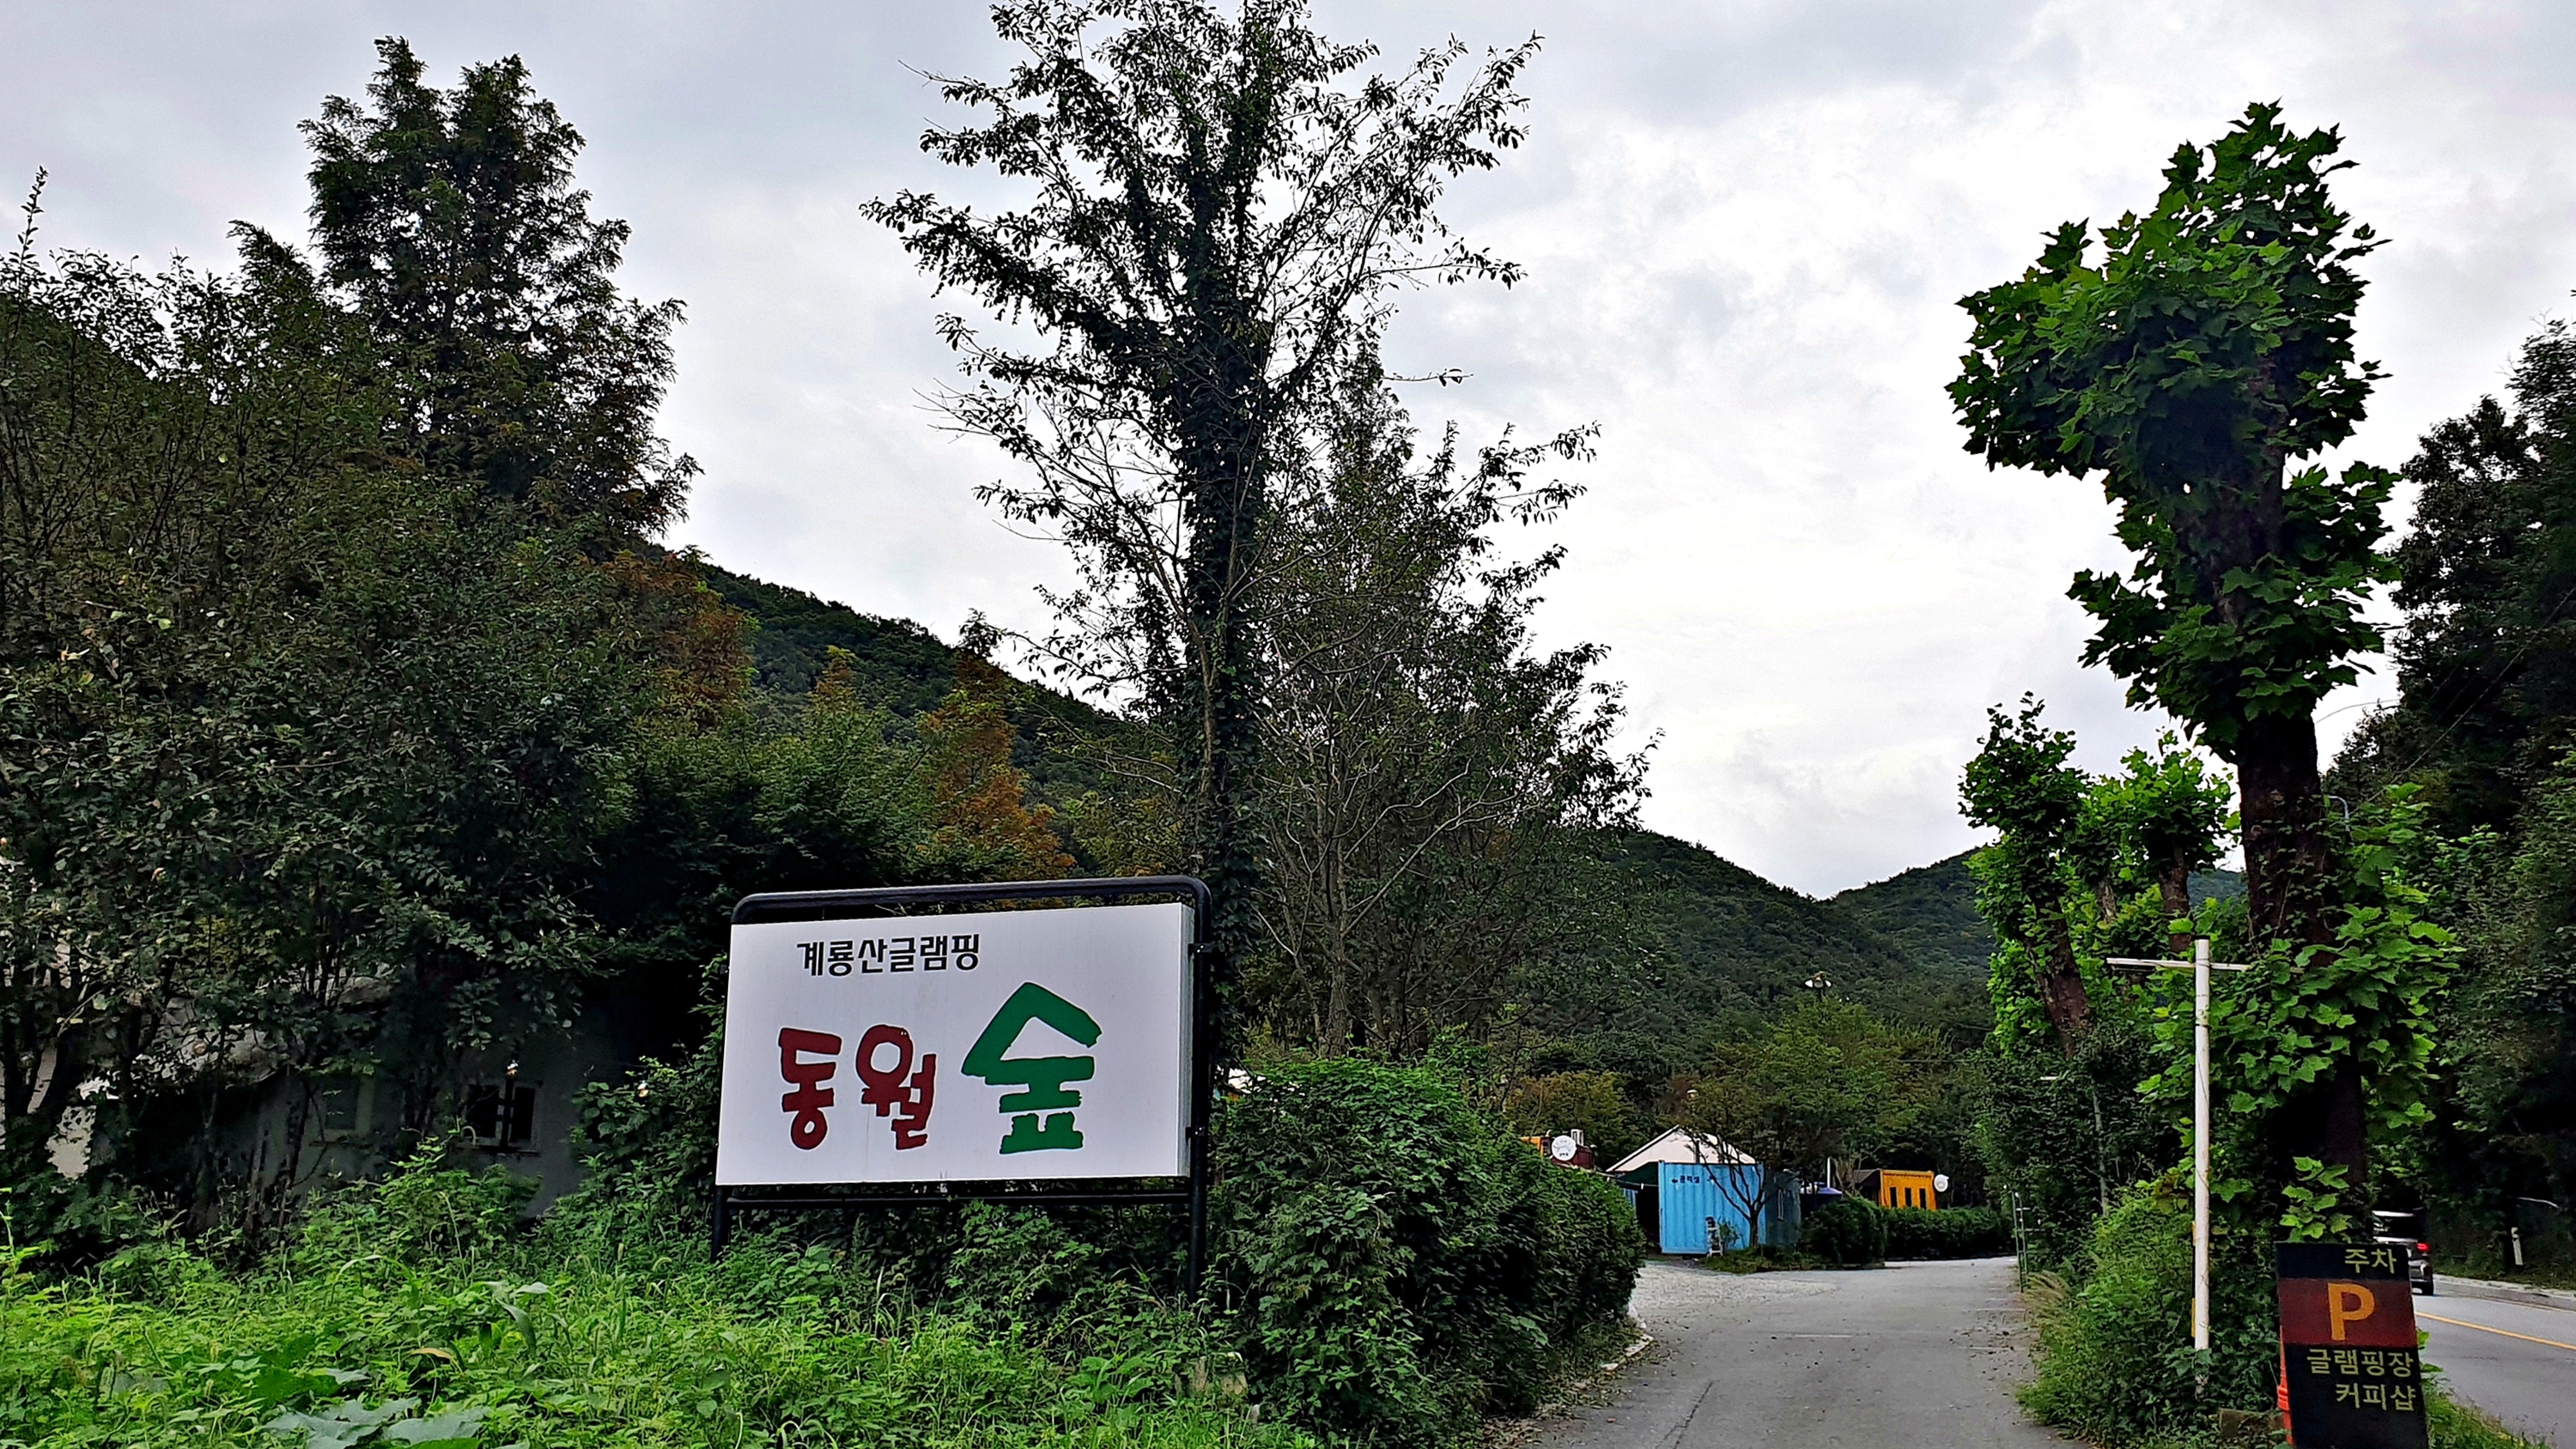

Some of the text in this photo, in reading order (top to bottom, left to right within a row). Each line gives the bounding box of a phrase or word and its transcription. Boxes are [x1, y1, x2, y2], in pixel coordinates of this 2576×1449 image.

[797, 934, 980, 977] 계룡산글램핑
[2344, 1248, 2397, 1274] 주차
[2327, 1282, 2375, 1341] P
[2306, 1349, 2415, 1378] 글램핑장
[2335, 1382, 2416, 1411] 커피샵
